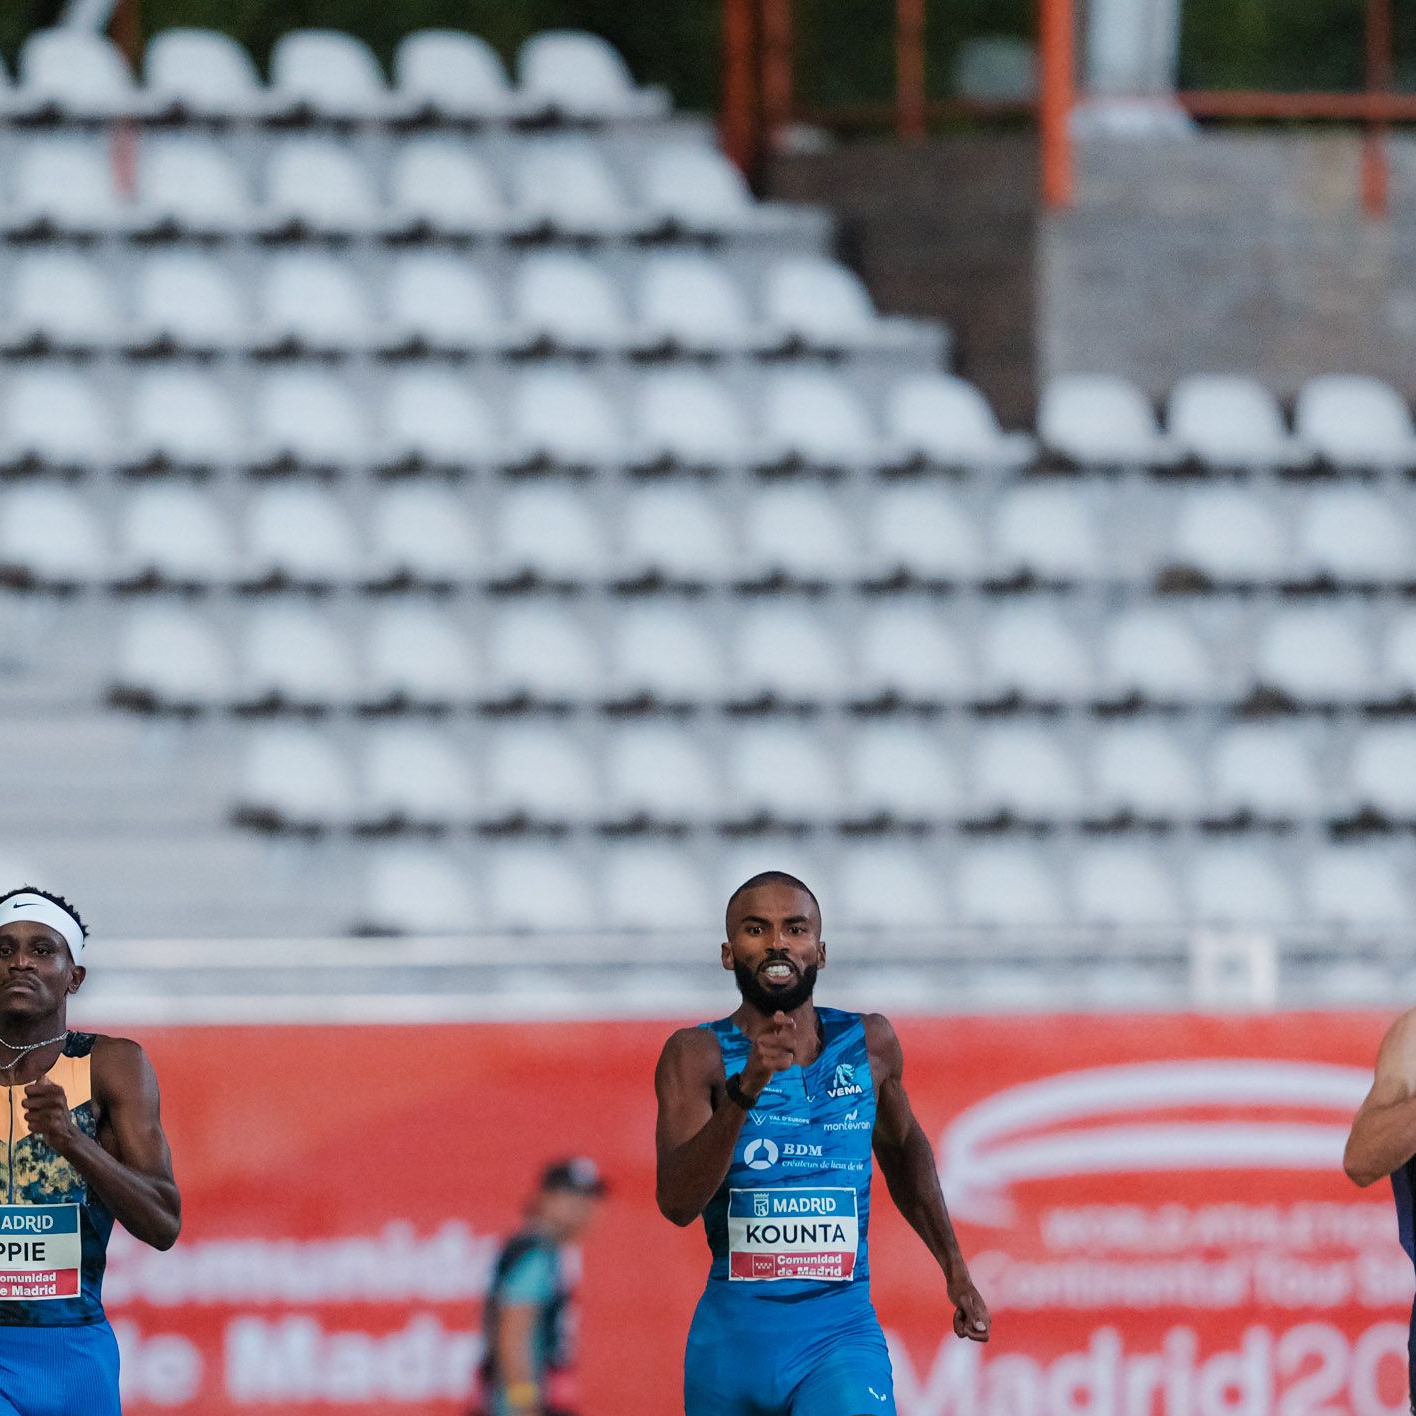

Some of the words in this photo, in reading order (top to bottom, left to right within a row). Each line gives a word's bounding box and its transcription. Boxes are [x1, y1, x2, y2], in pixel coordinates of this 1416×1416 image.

[827, 1084, 863, 1098] VEMA
[783, 1143, 823, 1157] BDM
[820, 1160, 830, 1169] de
[773, 1197, 837, 1215] MADRID
[746, 1223, 846, 1244] KOUNTA
[777, 1254, 842, 1265] Comunidad
[777, 1267, 793, 1277] de
[797, 1266, 842, 1277] Madrid
[11, 1284, 57, 1296] Madrid
